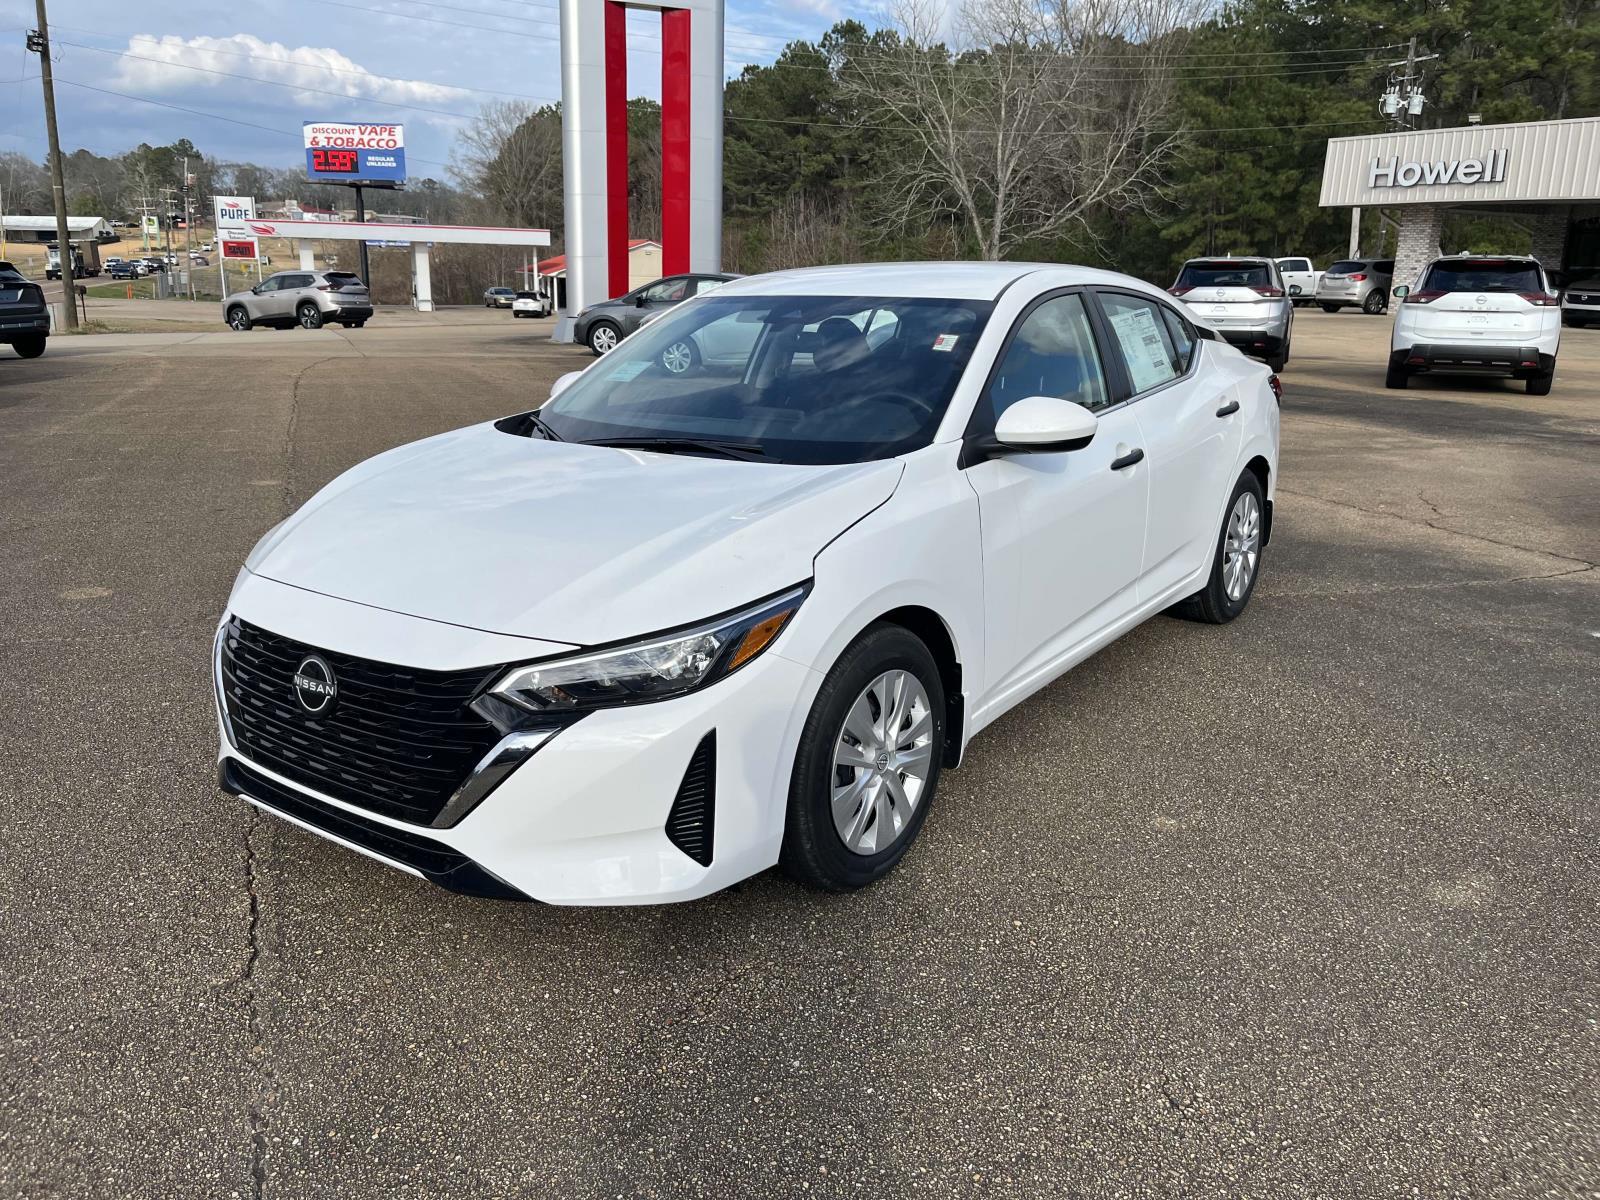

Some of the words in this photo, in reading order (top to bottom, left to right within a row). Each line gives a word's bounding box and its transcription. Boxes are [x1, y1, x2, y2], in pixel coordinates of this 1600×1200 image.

[312, 127, 356, 135] DISCOUNT
[358, 126, 397, 136] VAPE
[310, 136, 320, 146] &
[324, 137, 397, 149] TOBACCO
[1368, 149, 1508, 188] Howell
[220, 208, 250, 219] PURE
[294, 674, 334, 696] NISSAN
